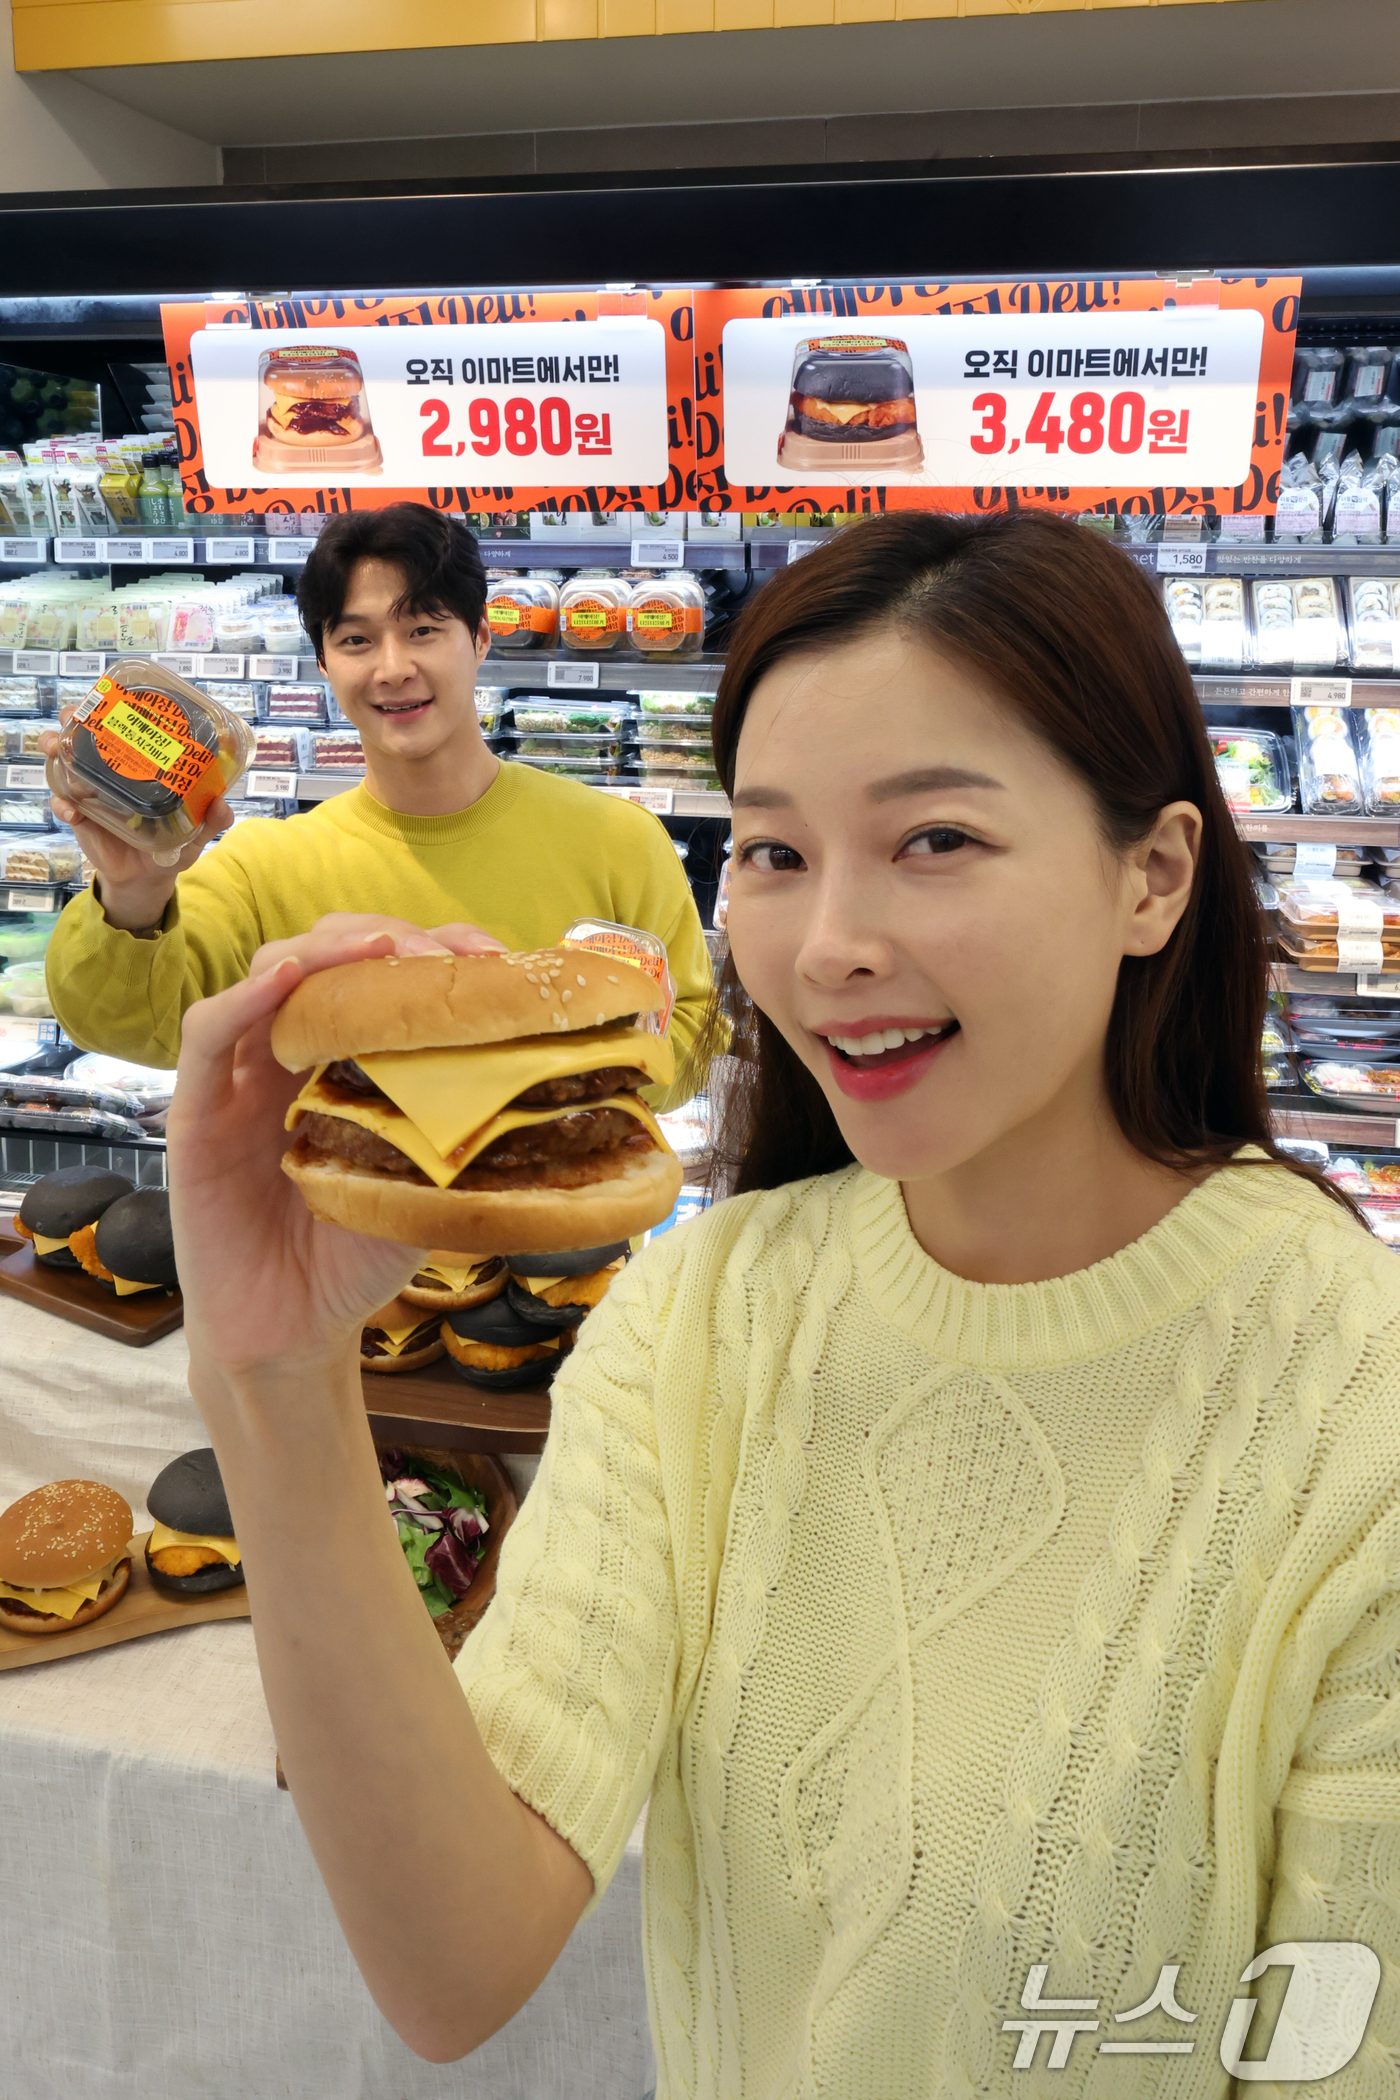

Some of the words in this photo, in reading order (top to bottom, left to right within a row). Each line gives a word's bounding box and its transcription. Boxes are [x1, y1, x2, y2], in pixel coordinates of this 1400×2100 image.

[406, 358, 454, 385] 오직
[462, 354, 620, 384] 이마트에서만!
[963, 349, 1018, 379] 오직
[1027, 346, 1208, 378] 이마트에서만!
[419, 397, 612, 457] 2,980원
[970, 391, 1190, 454] 3,480원
[1172, 554, 1203, 566] 1,580
[1216, 554, 1240, 564] 맛있는
[1243, 555, 1266, 564] 반찬을
[1269, 555, 1301, 565] 다양하게
[1214, 687, 1246, 696] 든든하고
[1248, 688, 1280, 697] 간편하게
[126, 714, 172, 750] 어메이징!
